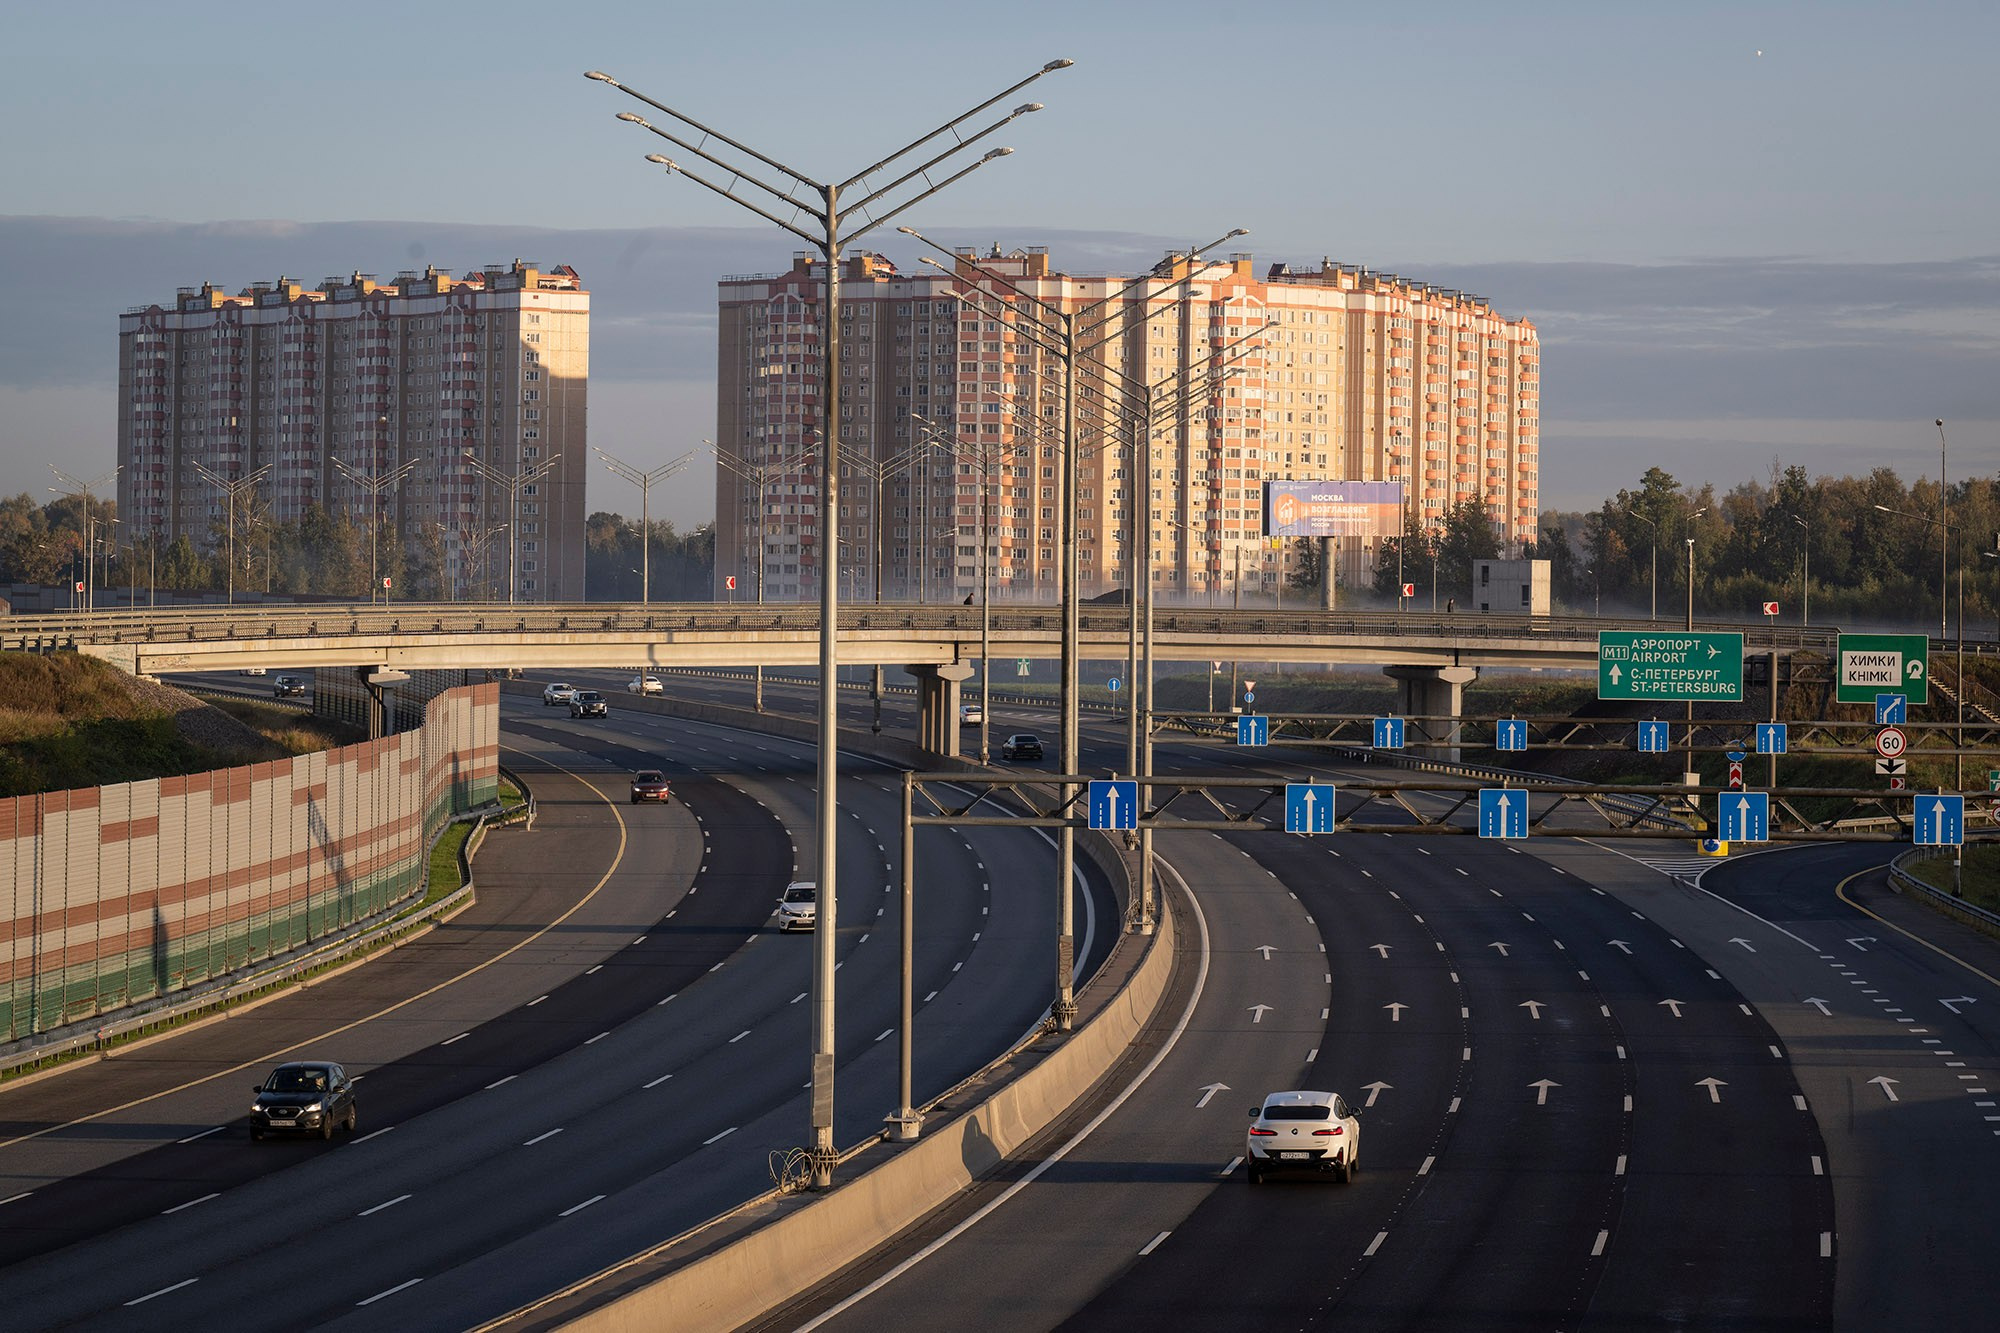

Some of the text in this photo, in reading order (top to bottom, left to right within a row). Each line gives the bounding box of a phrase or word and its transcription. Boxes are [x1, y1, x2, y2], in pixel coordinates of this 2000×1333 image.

[1311, 494, 1344, 502] МОСКВА
[1311, 505, 1368, 514] ВОЗГЛАВЛЯЕТ
[1631, 639, 1701, 651] АЭРОПОРТ
[1631, 652, 1687, 663] AIRPORT
[1849, 655, 1895, 666] ХИМКИ
[1631, 668, 1720, 680] С.-ПЕТЕРБУРГ
[1849, 671, 1892, 682] KHIMKI
[1631, 681, 1736, 694] ST.-PETERSBURG
[1882, 737, 1899, 749] 60
